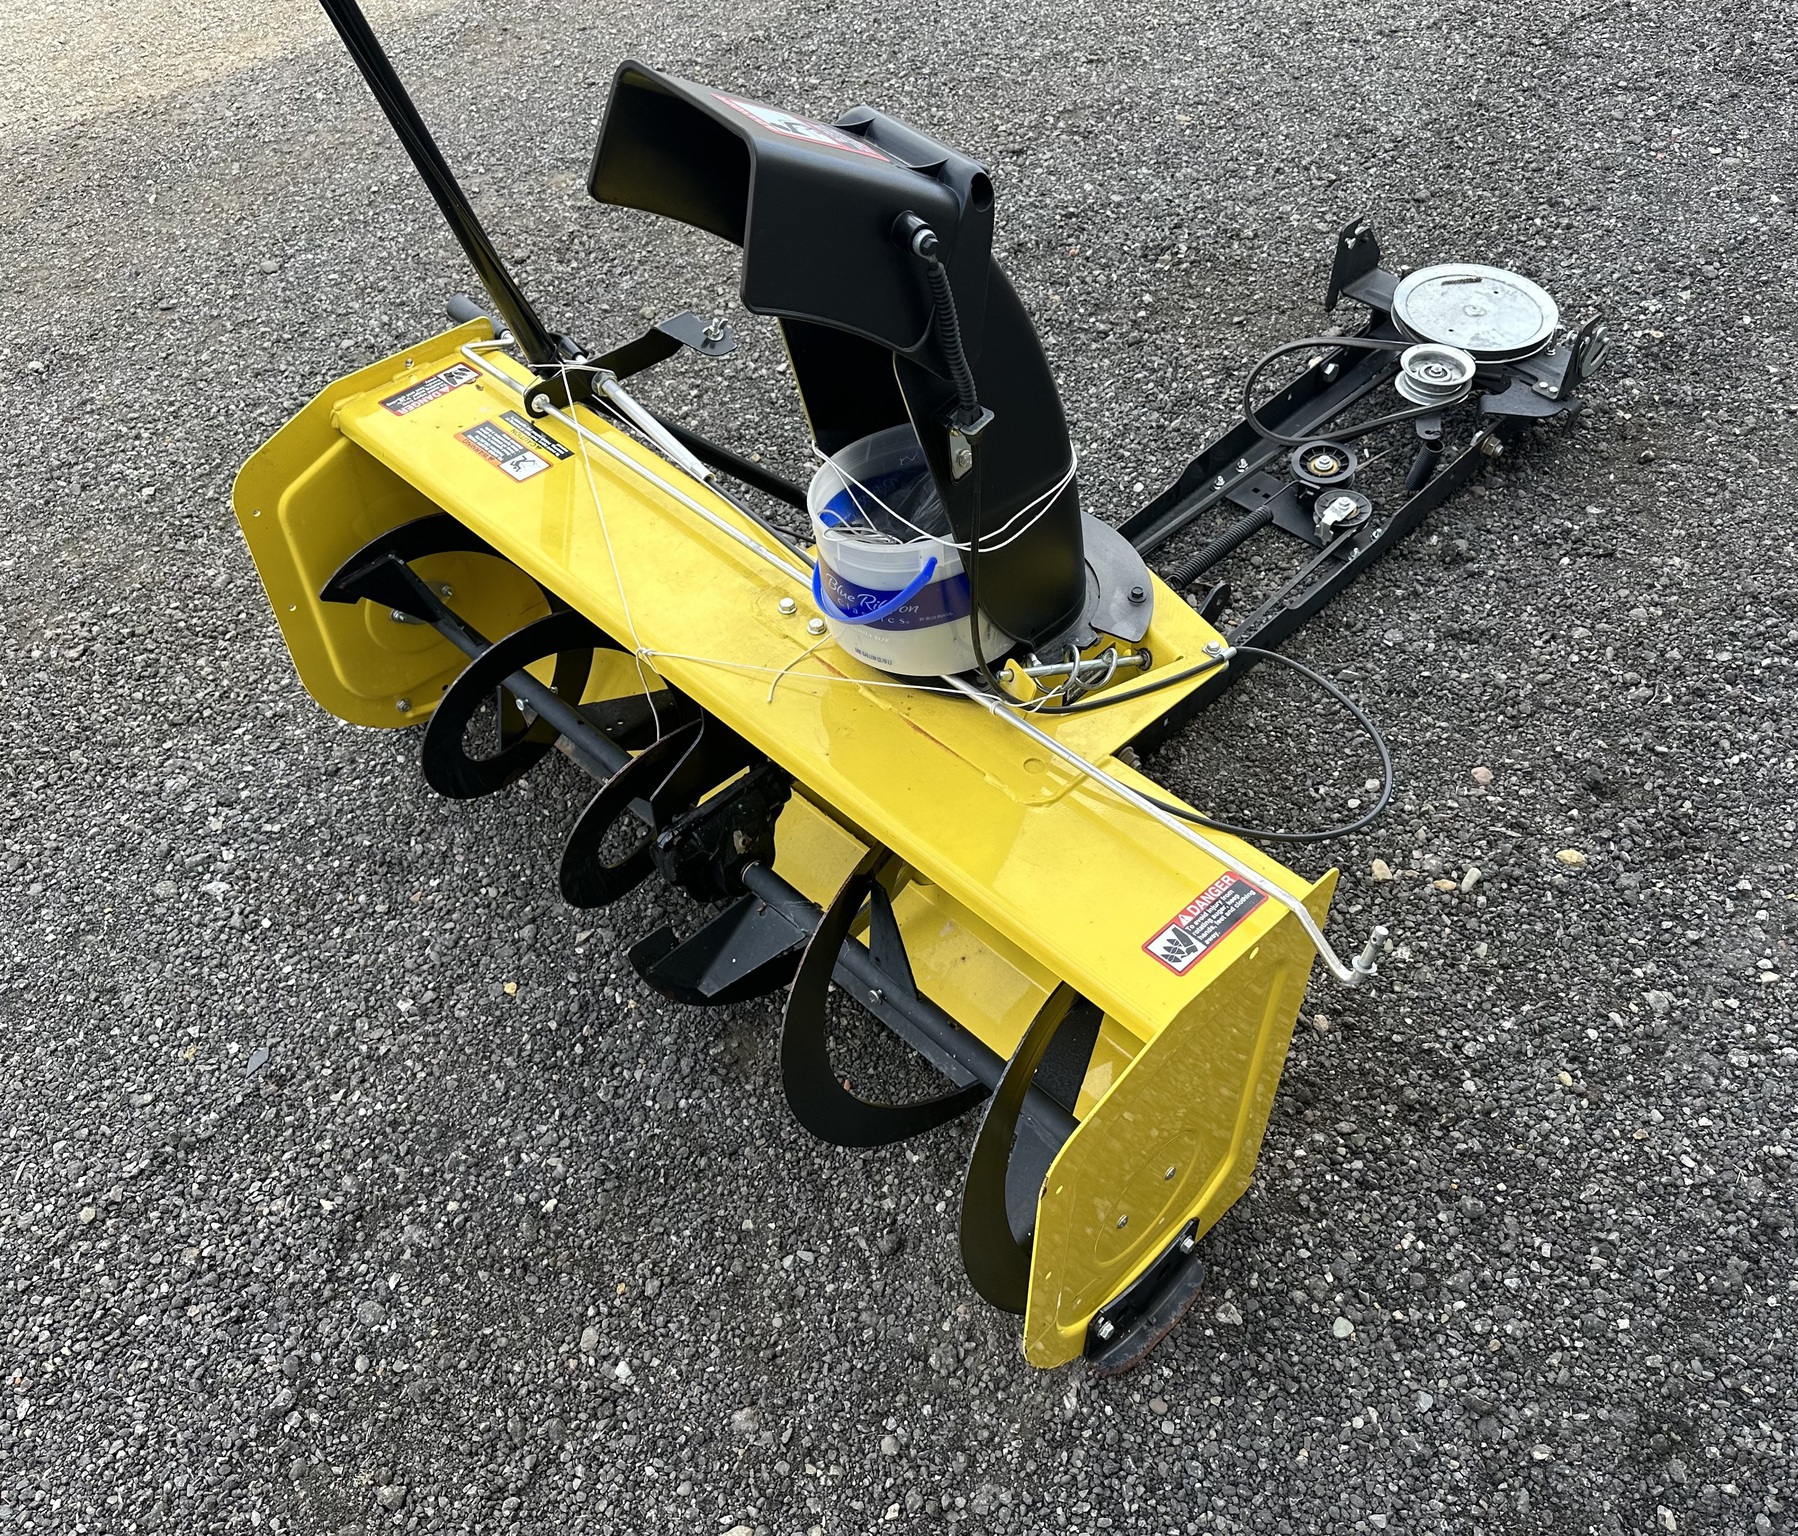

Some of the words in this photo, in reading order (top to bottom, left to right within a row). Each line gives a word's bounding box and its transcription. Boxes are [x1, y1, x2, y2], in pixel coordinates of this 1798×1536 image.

[397, 391, 441, 414] DANGER
[826, 573, 855, 602] Blue
[857, 593, 920, 613] Rion
[1185, 924, 1195, 932] To
[1193, 911, 1209, 926] avoid
[1206, 899, 1224, 914] injury
[1220, 889, 1234, 901] from
[1186, 875, 1236, 916] DANGER
[1192, 918, 1214, 937] rotating
[1211, 905, 1229, 920] auger,
[1225, 893, 1240, 906] keep
[1197, 925, 1218, 941] hands,
[1214, 914, 1227, 926] feet
[1224, 906, 1236, 917] and
[1234, 889, 1257, 909] clothing
[1204, 931, 1221, 945] away.
